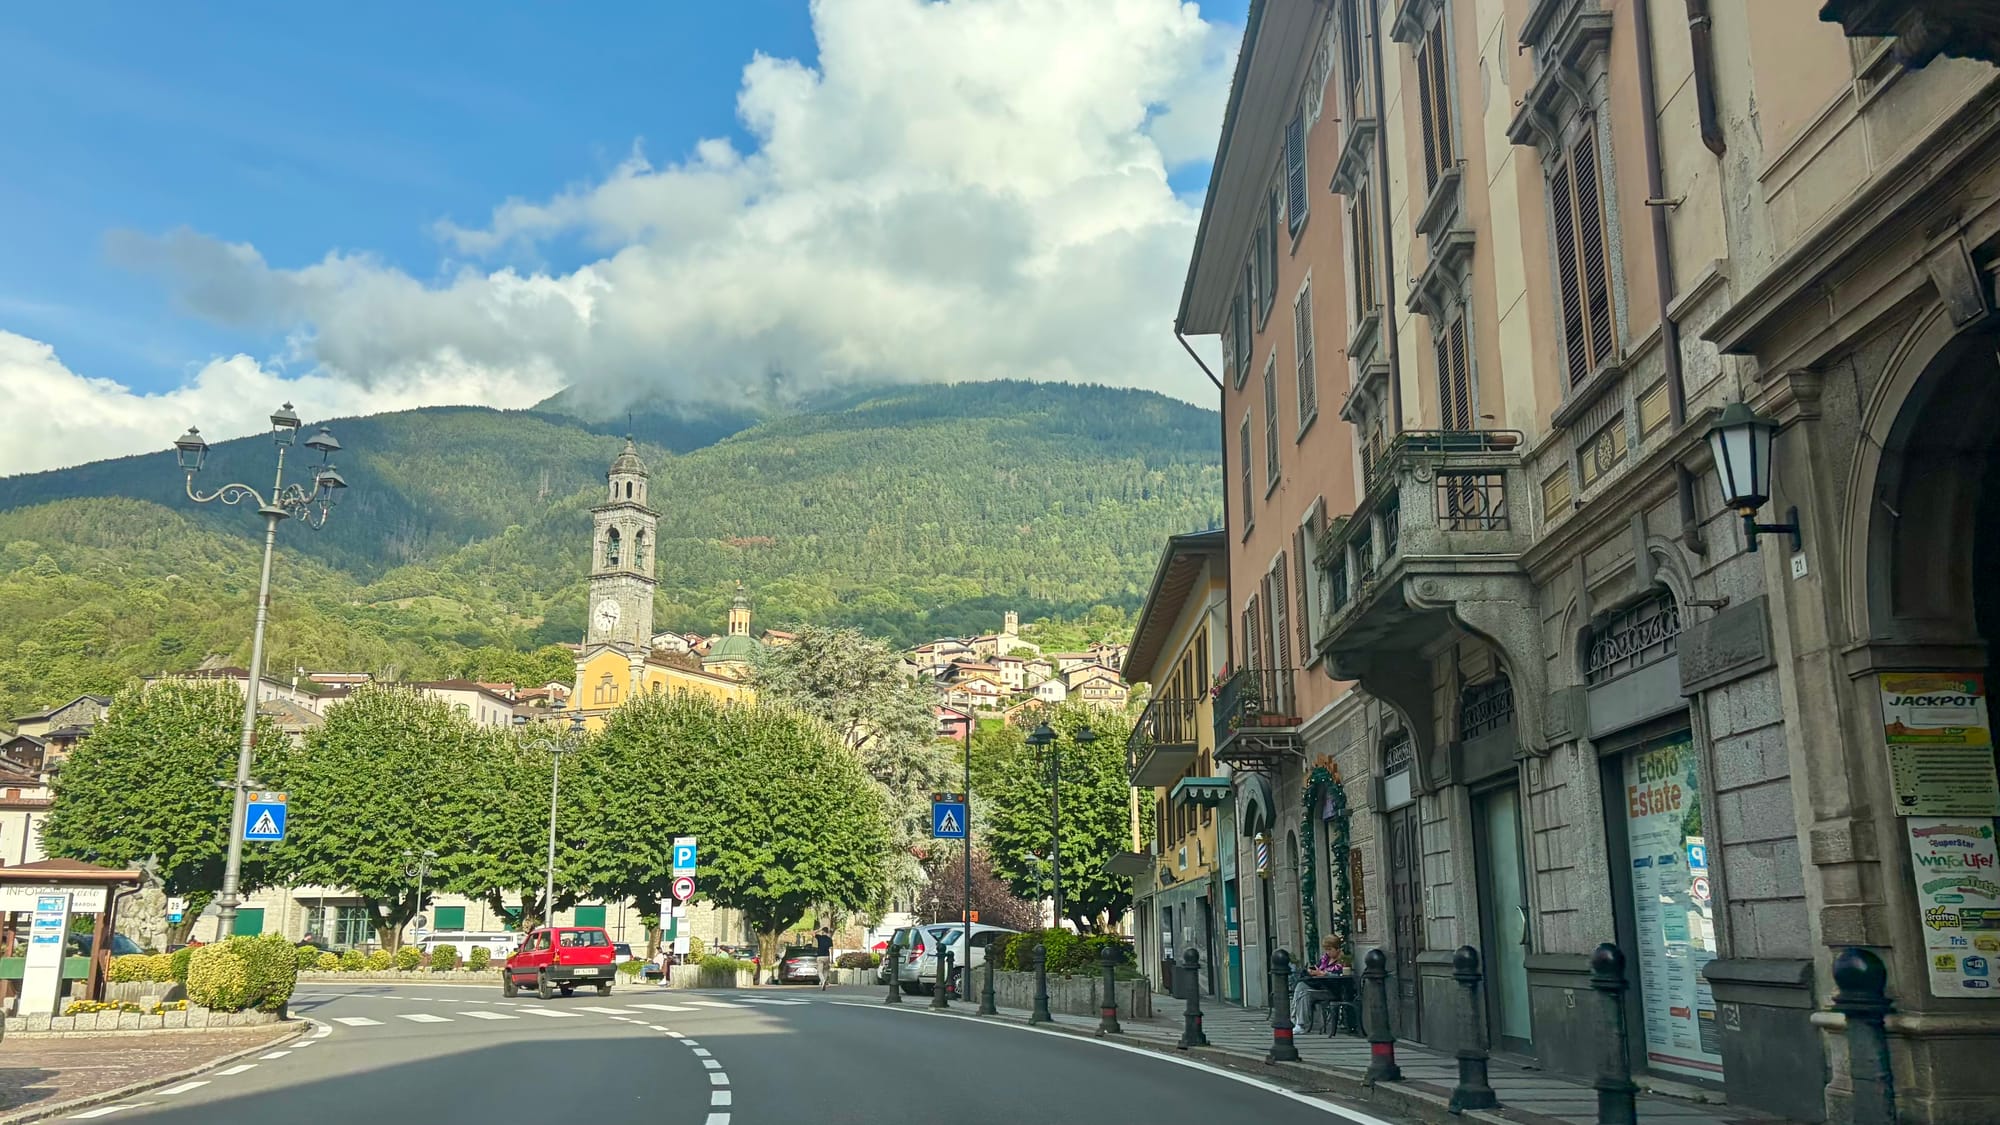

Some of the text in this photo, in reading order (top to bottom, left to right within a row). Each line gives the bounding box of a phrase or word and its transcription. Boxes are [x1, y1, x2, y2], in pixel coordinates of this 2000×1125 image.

[1889, 695, 1981, 707] JACKPOT
[1637, 752, 1679, 784] Edolo
[1629, 781, 1682, 818] Estate
[1933, 838, 1975, 848] SuperStar
[678, 847, 692, 867] P
[1926, 913, 1955, 921] Gratta
[1950, 936, 1968, 946] Tris
